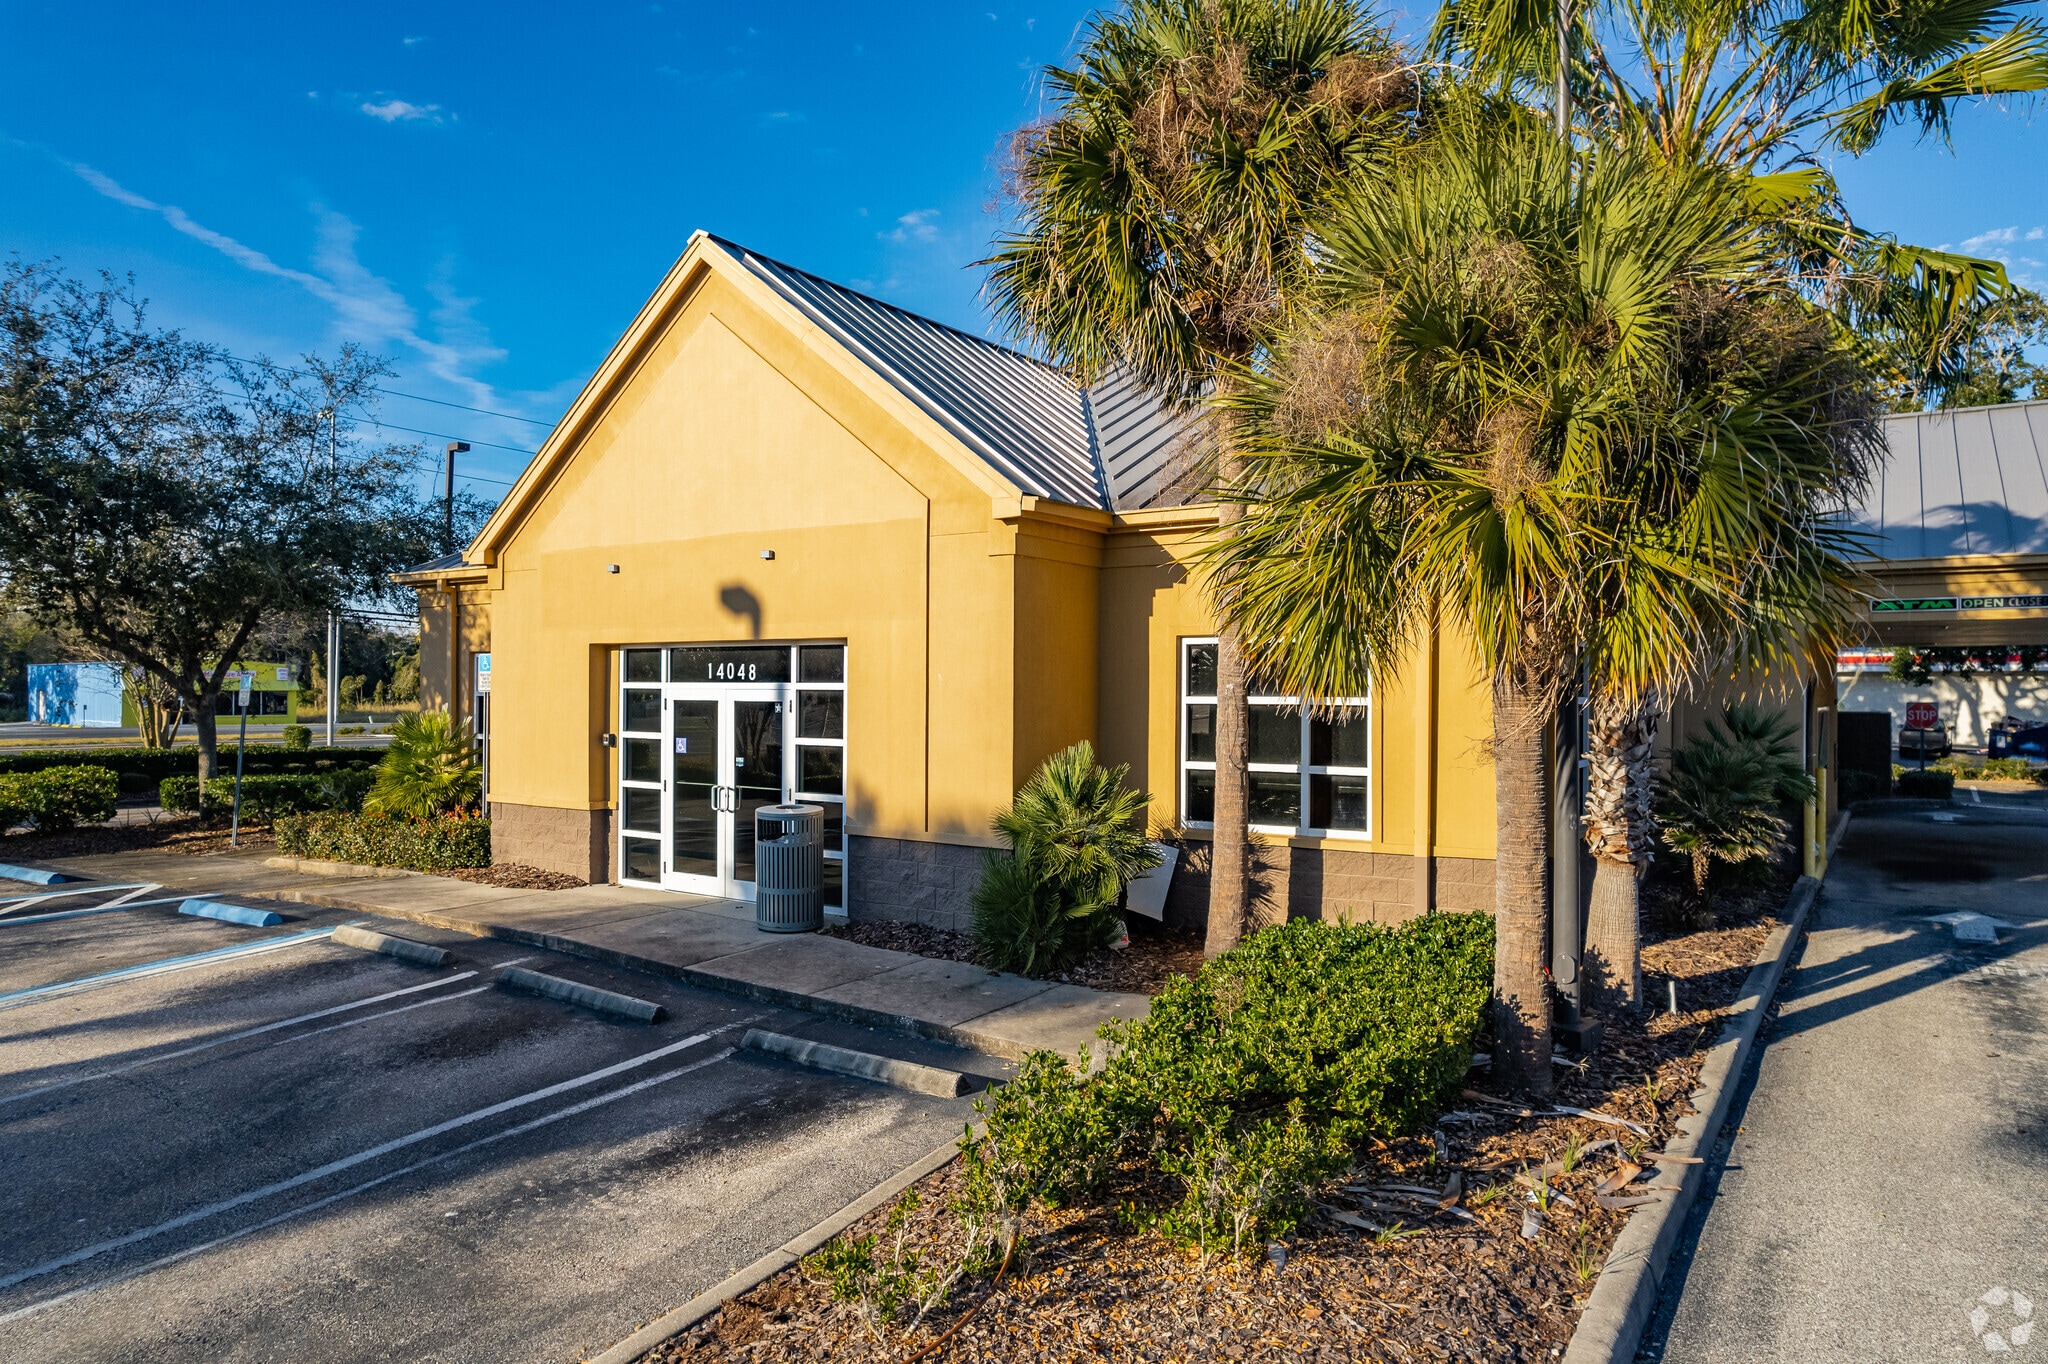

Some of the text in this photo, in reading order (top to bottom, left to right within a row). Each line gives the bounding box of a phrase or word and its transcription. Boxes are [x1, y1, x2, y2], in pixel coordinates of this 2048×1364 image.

[1875, 600, 1953, 610] ATM
[1963, 598, 2004, 608] OPEN
[708, 662, 756, 680] 14048
[1907, 710, 1936, 720] STOP
